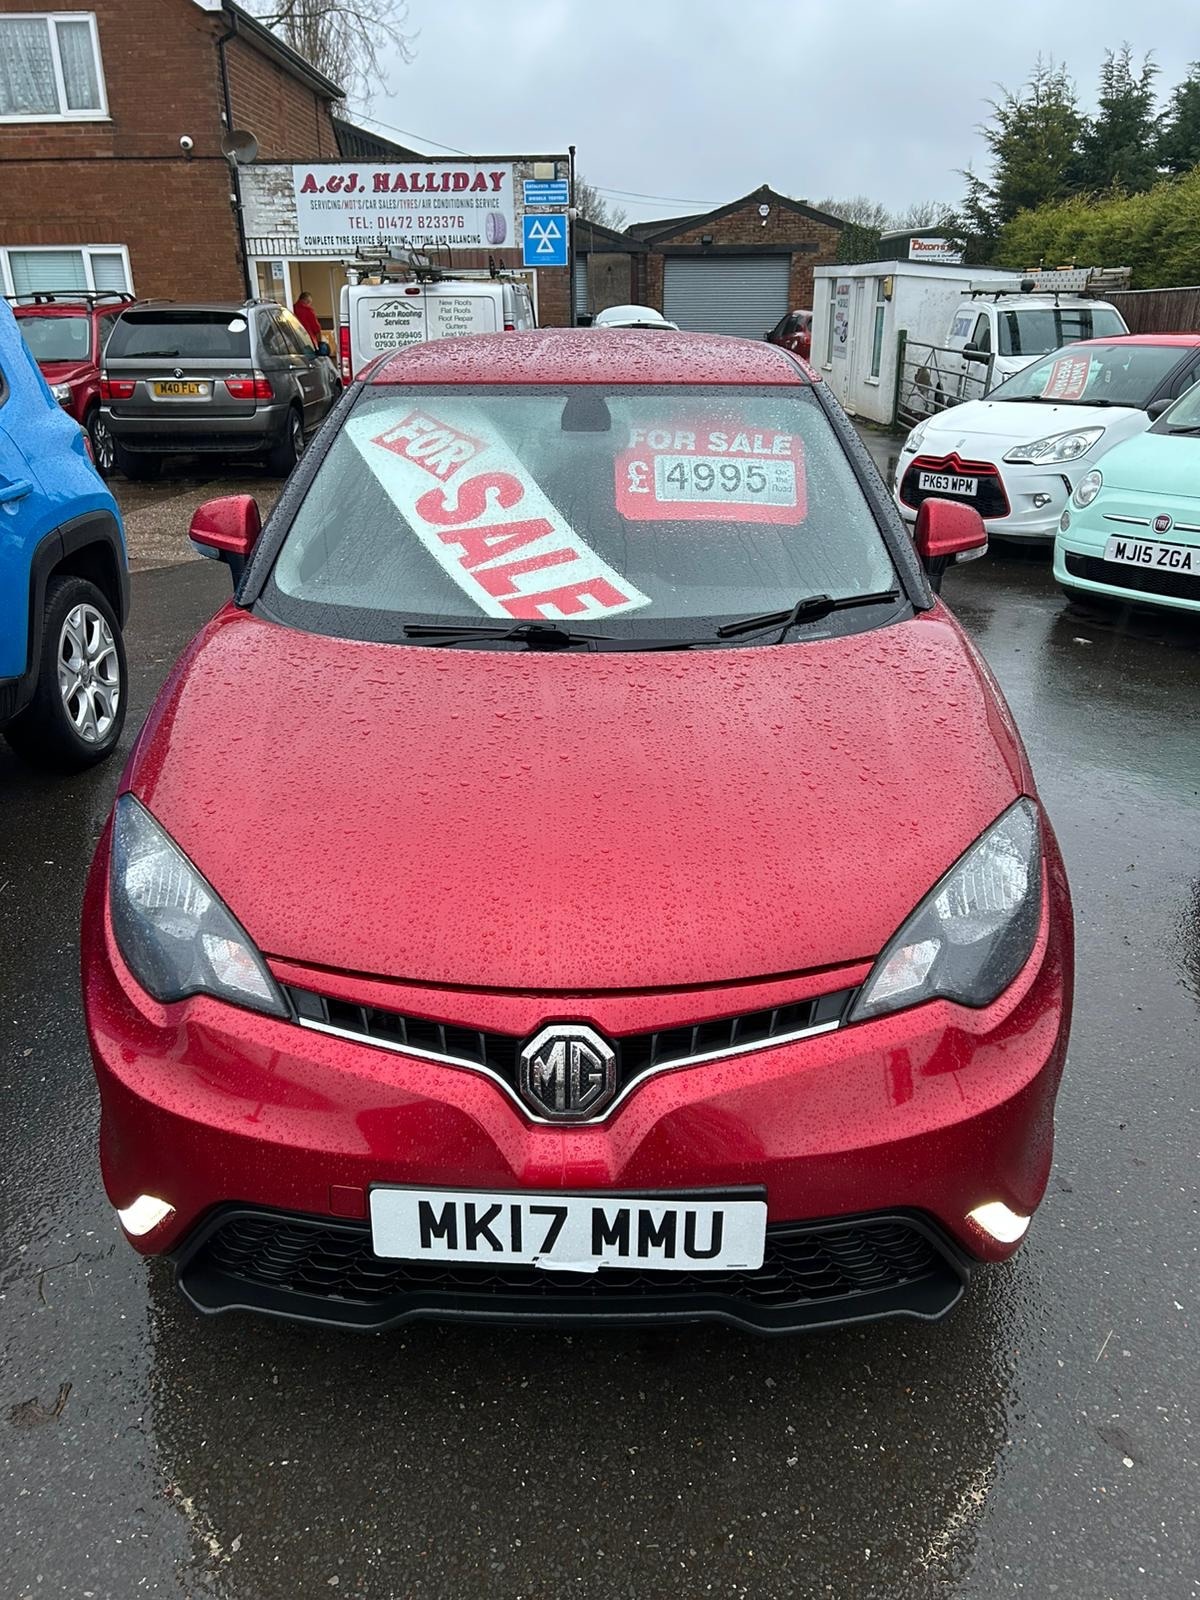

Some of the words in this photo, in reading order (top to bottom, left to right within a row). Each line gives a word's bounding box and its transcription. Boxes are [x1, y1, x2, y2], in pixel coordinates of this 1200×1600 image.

[372, 171, 506, 193] HALLIDAY
[433, 198, 474, 209] CONDITIONING
[475, 198, 500, 208] SERVICE
[348, 216, 374, 229] TEL:
[377, 215, 412, 229] 01472
[417, 215, 465, 228] 823376
[304, 235, 335, 245] COMPLETE
[335, 235, 350, 245] TYRE
[351, 235, 375, 245] SERVICE
[411, 234, 434, 244] FITTING
[436, 234, 447, 244] AND
[448, 234, 481, 244] BALANCING
[397, 310, 422, 319] Roofing
[383, 418, 476, 475] FOR
[628, 428, 697, 450] FOR
[707, 431, 792, 455] SALE
[628, 460, 650, 494] £
[667, 462, 767, 493] 4995
[923, 474, 950, 490] PK63
[951, 477, 973, 493] WPM
[415, 471, 631, 620] SALE
[1114, 541, 1153, 563] MJ15
[1157, 548, 1191, 570] ZGA
[533, 1040, 603, 1111] MG
[417, 1199, 569, 1255] MK17
[591, 1207, 724, 1260] MMU
